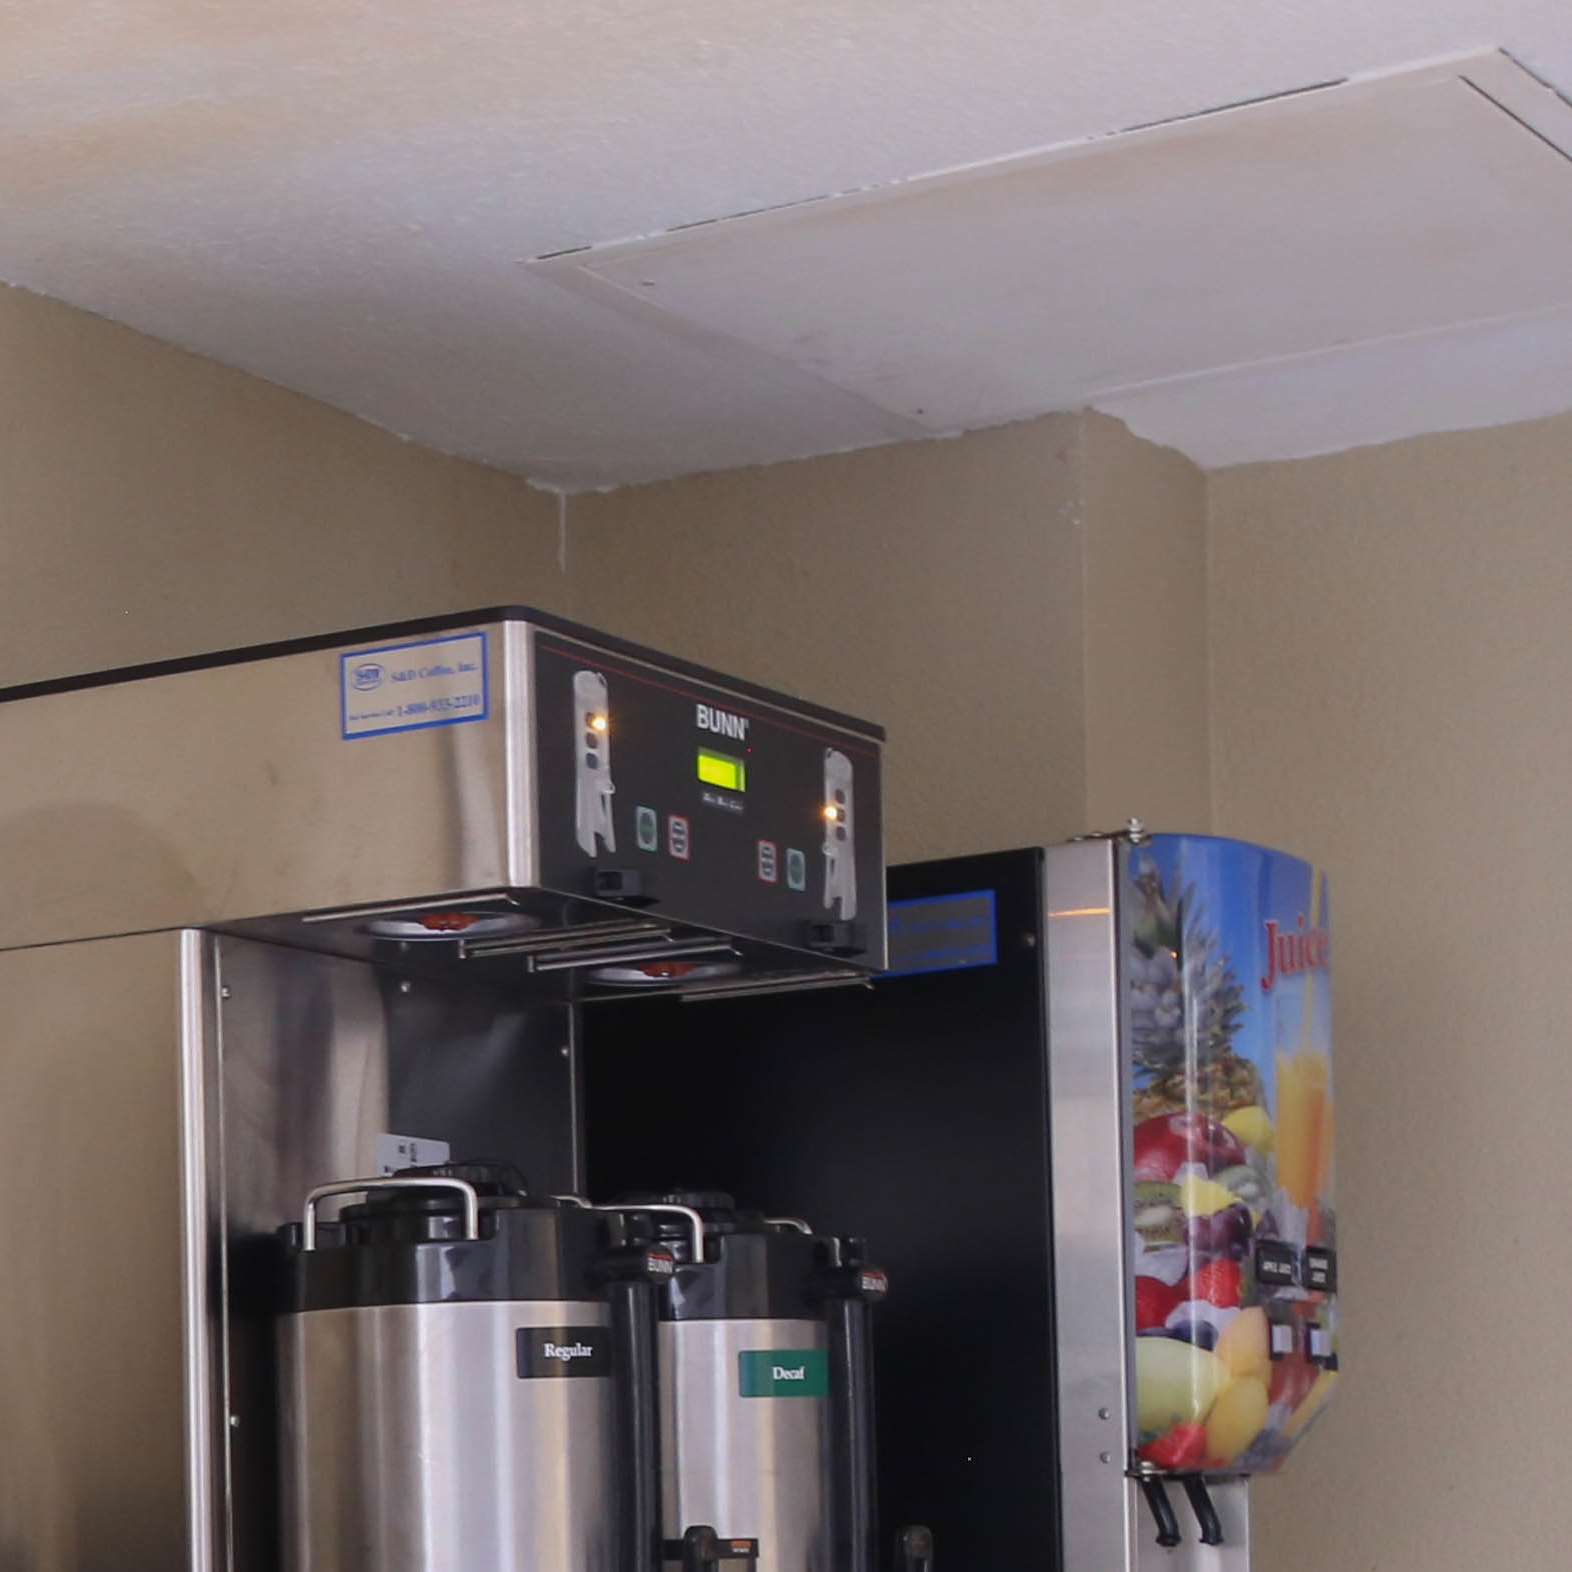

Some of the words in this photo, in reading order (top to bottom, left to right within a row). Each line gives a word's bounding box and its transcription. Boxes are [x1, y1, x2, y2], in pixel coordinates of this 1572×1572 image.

[696, 703, 746, 741] BUNN
[1260, 913, 1328, 991] Juice
[543, 1342, 593, 1361] Regular
[772, 1365, 805, 1380] Decaf
